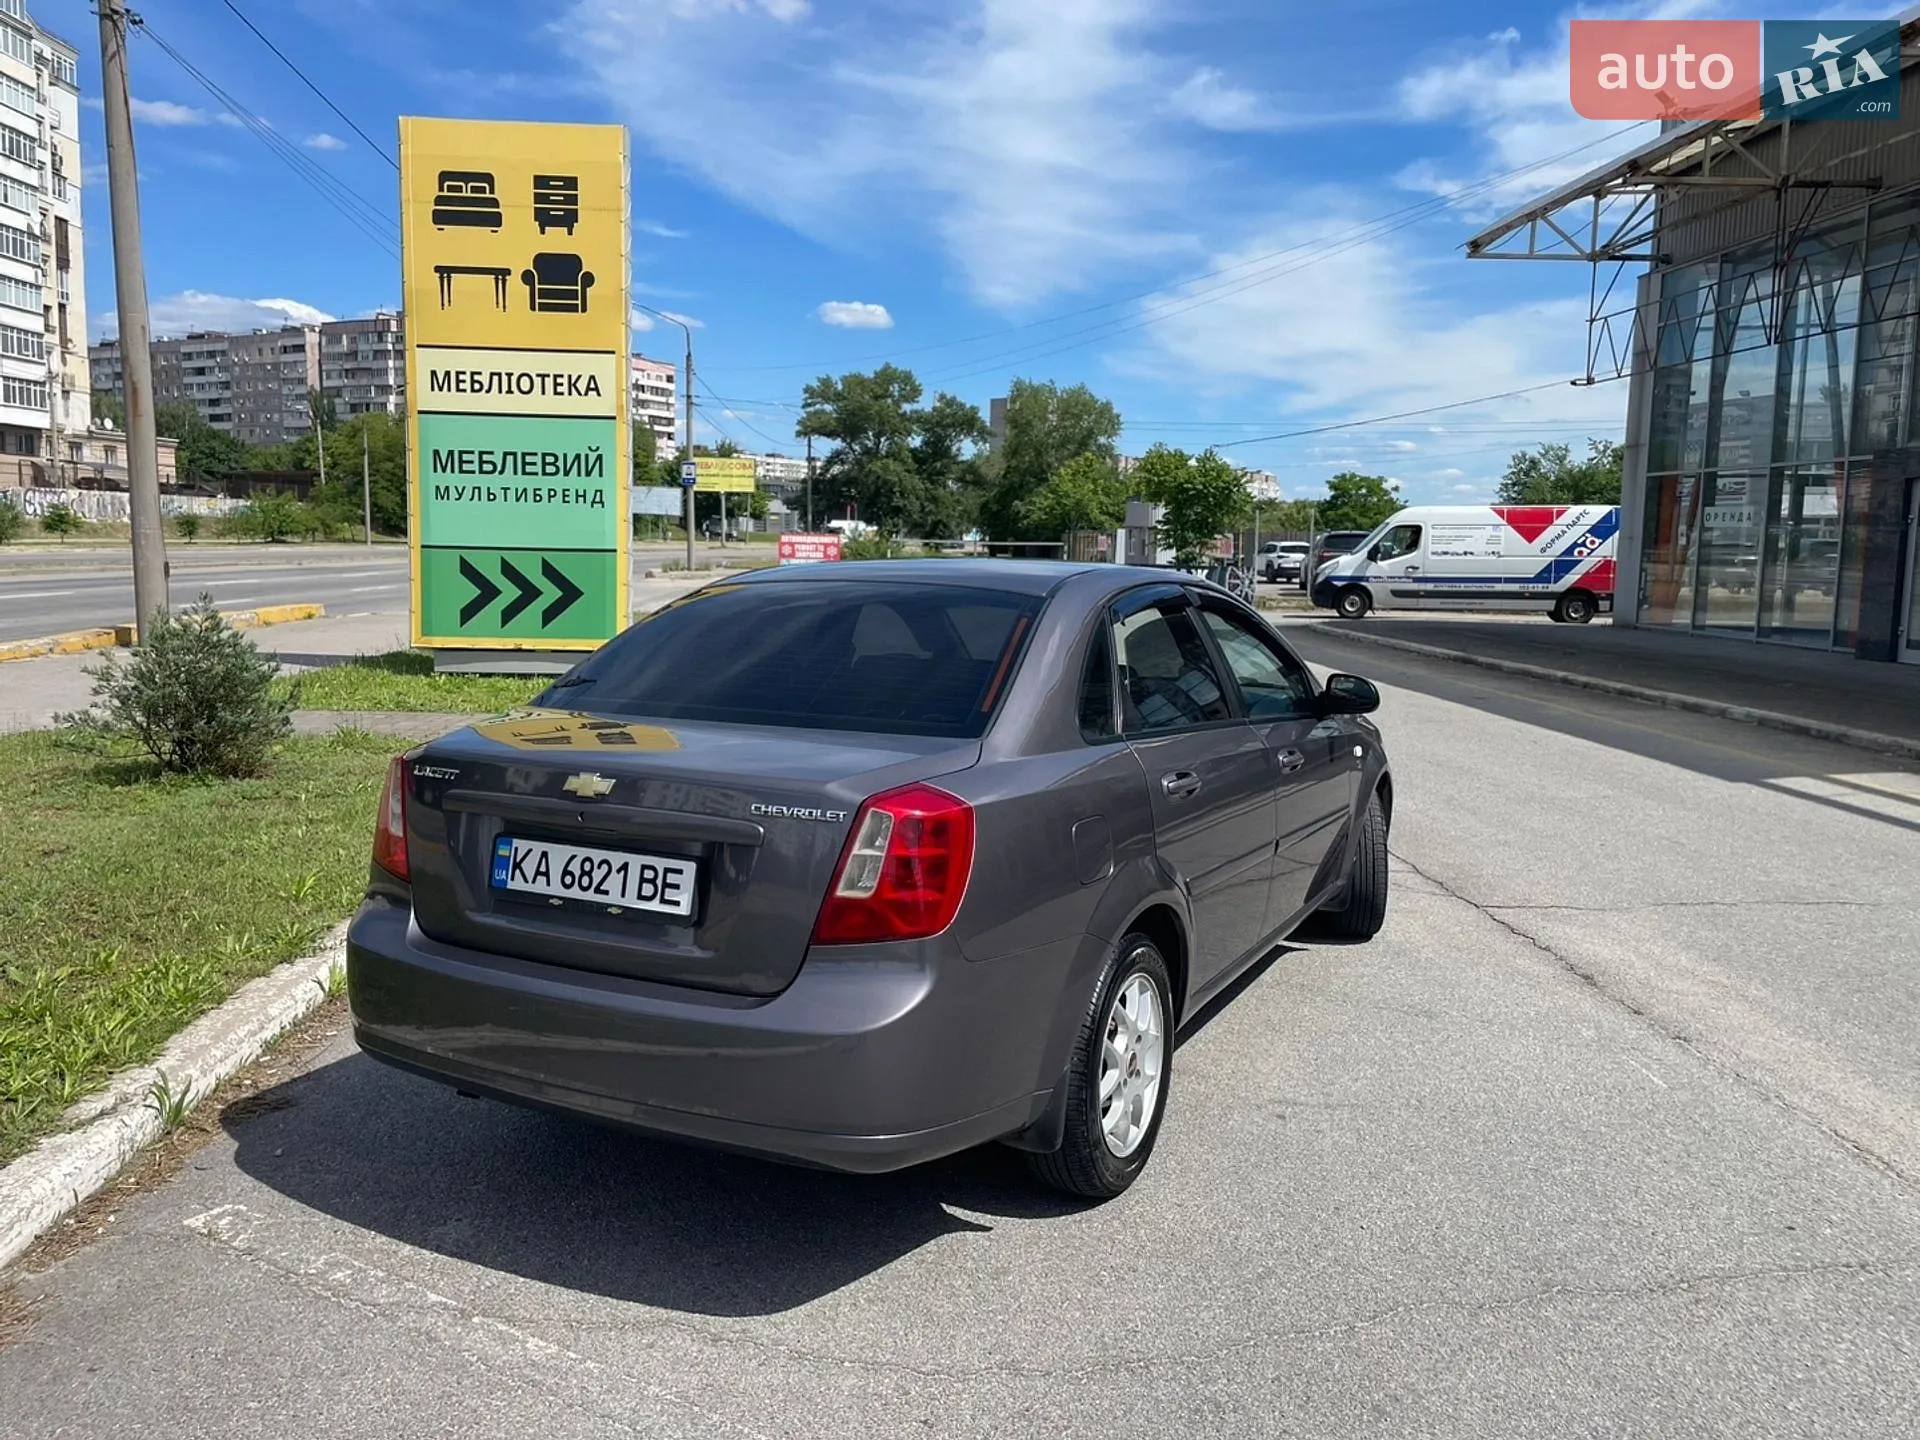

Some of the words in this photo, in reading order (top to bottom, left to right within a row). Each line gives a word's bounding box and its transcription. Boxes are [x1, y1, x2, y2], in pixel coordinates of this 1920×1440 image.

[430, 369, 602, 397] МЕБЛІОТЕКА
[432, 446, 604, 478] МЕБЛЕВИЙ
[434, 485, 606, 509] МУЛЬТИБРЕНД
[1705, 511, 1752, 522] ОРЕНДА
[1540, 529, 1568, 554] ФОРМА
[1566, 508, 1591, 531] ПАРТС
[750, 803, 848, 822] CHEVROLET
[494, 869, 508, 881] UA
[510, 846, 551, 887] KA
[560, 854, 630, 899] 6821
[636, 863, 684, 907] BE
